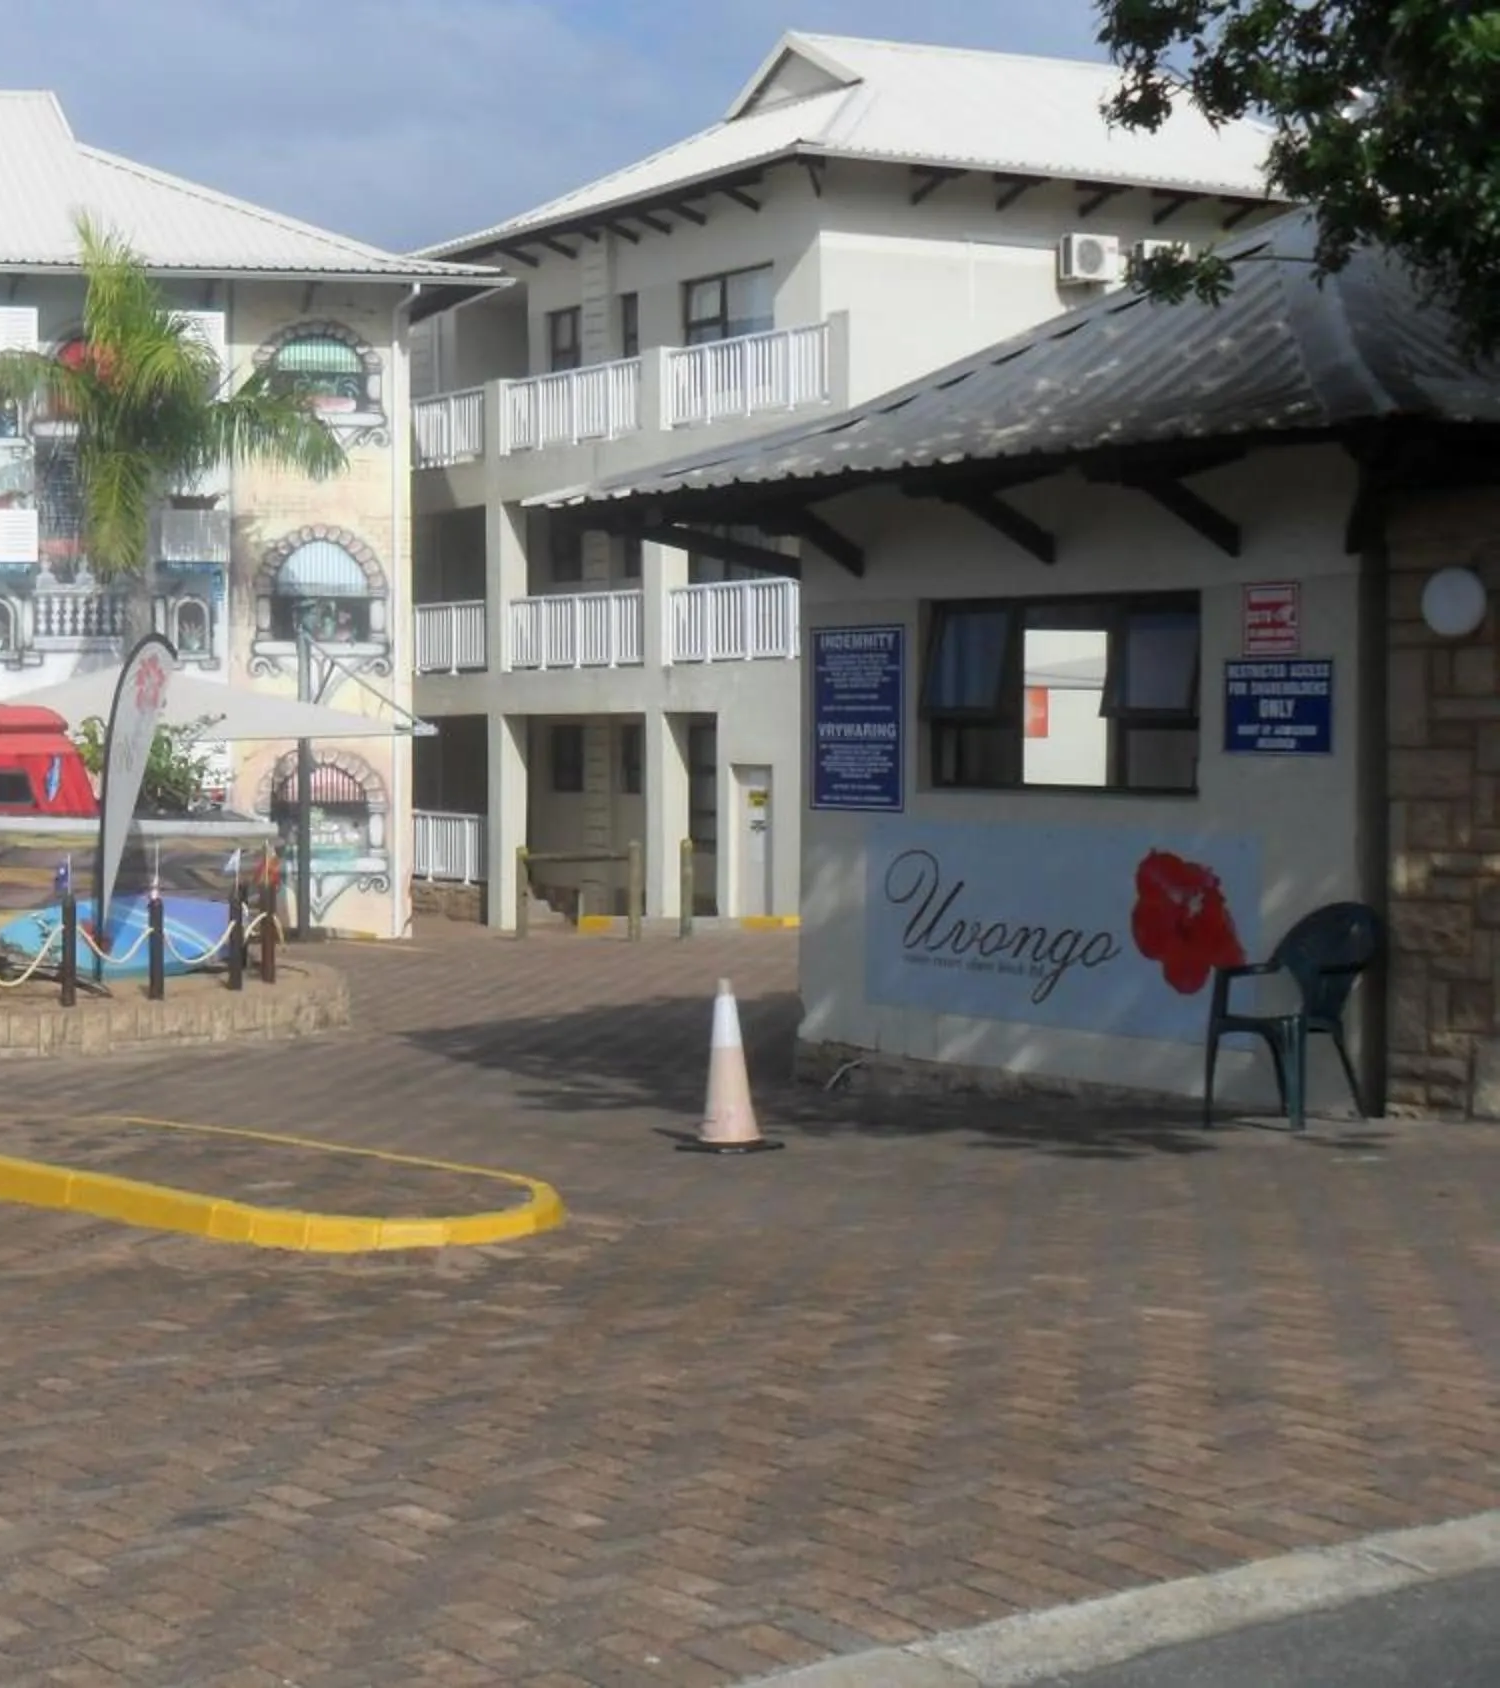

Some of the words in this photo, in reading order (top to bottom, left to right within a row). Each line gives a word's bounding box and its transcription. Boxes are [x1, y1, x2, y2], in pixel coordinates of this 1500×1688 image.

[820, 633, 895, 650] INDEMNITY
[1259, 698, 1295, 718] ONLY
[818, 722, 897, 738] VRYWARING
[885, 850, 1122, 1004] Uvongo
